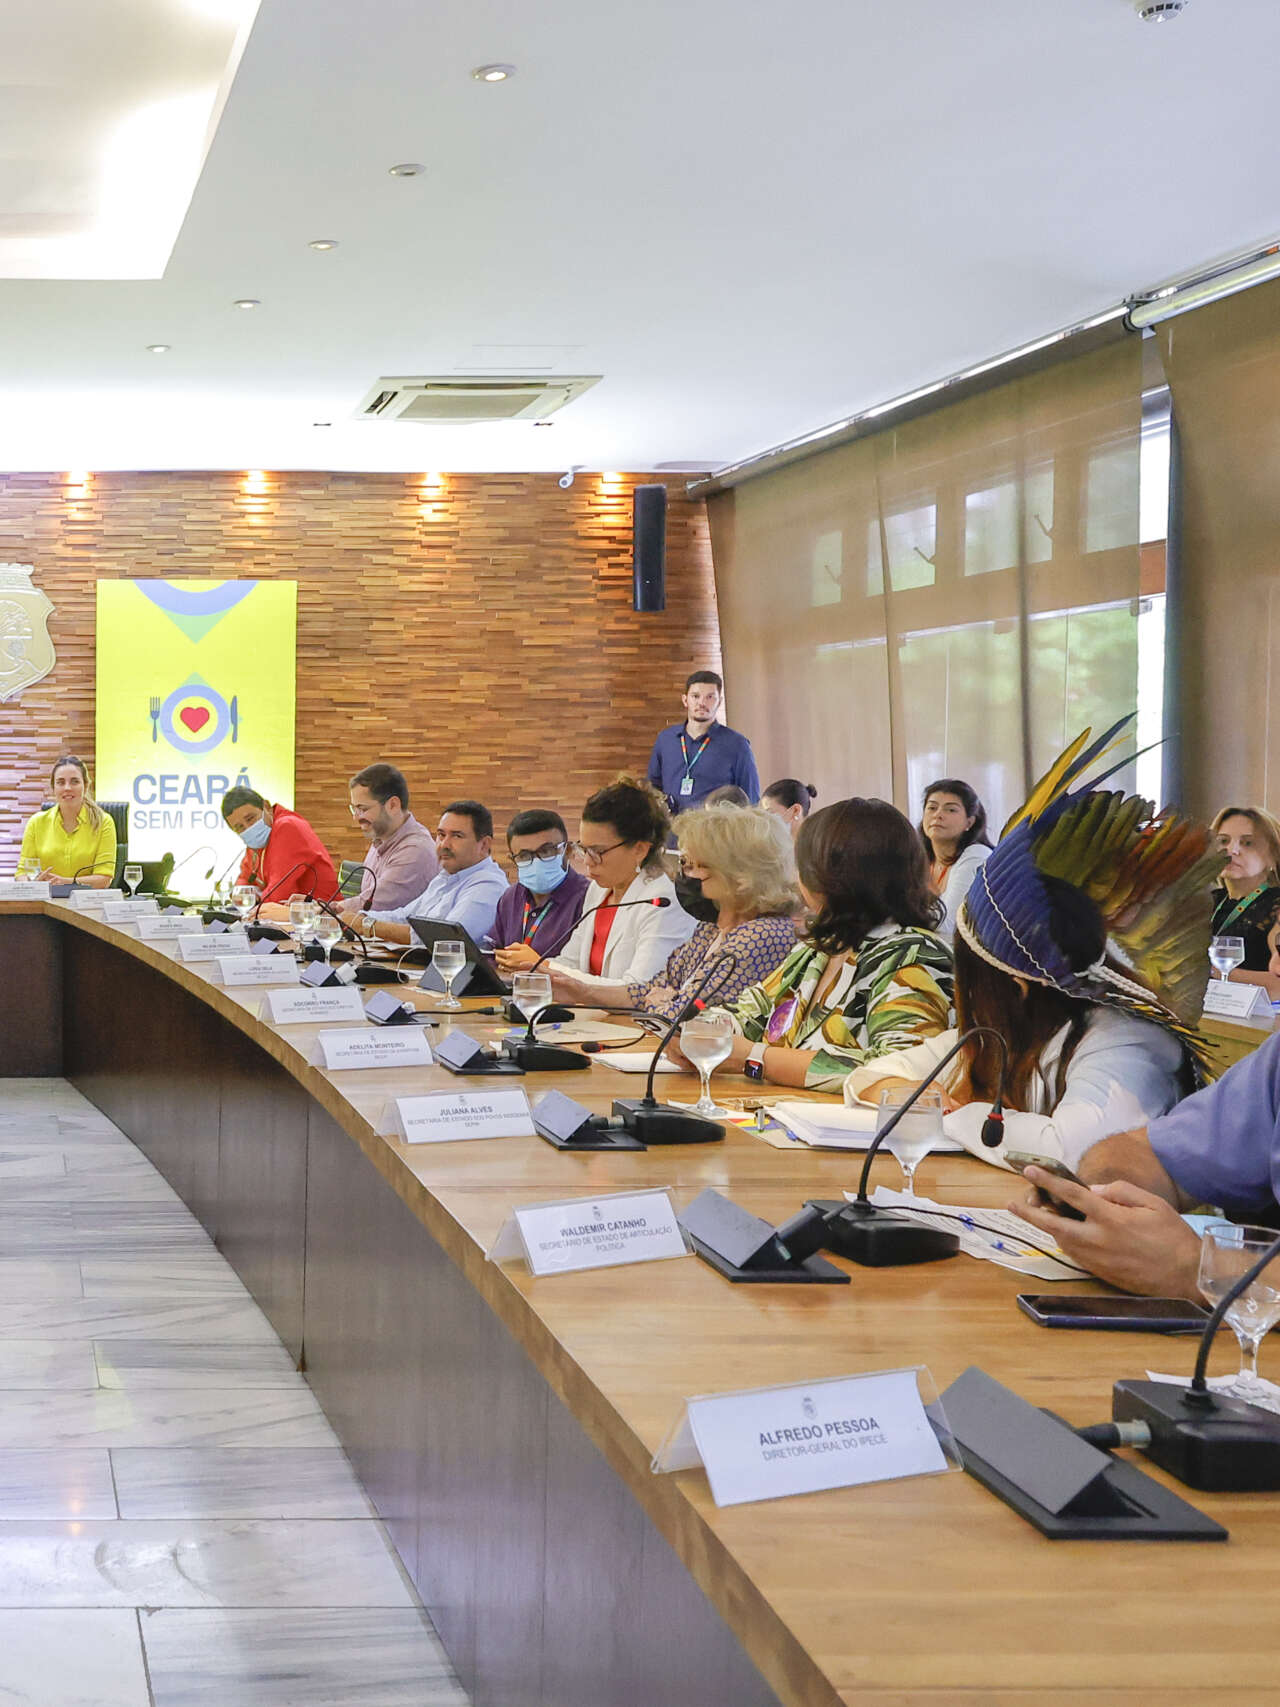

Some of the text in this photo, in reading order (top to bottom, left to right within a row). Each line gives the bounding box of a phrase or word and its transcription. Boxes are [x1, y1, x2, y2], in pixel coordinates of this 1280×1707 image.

[133, 810, 225, 829] SEM FO
[440, 1104, 493, 1116] JULIANA ALVES
[560, 1218, 647, 1236] WALDEMIR CATANHO
[759, 1417, 881, 1447] ALFREDO PESSOA
[762, 1433, 889, 1461] DIRETOR-GERAL DO IPECE
